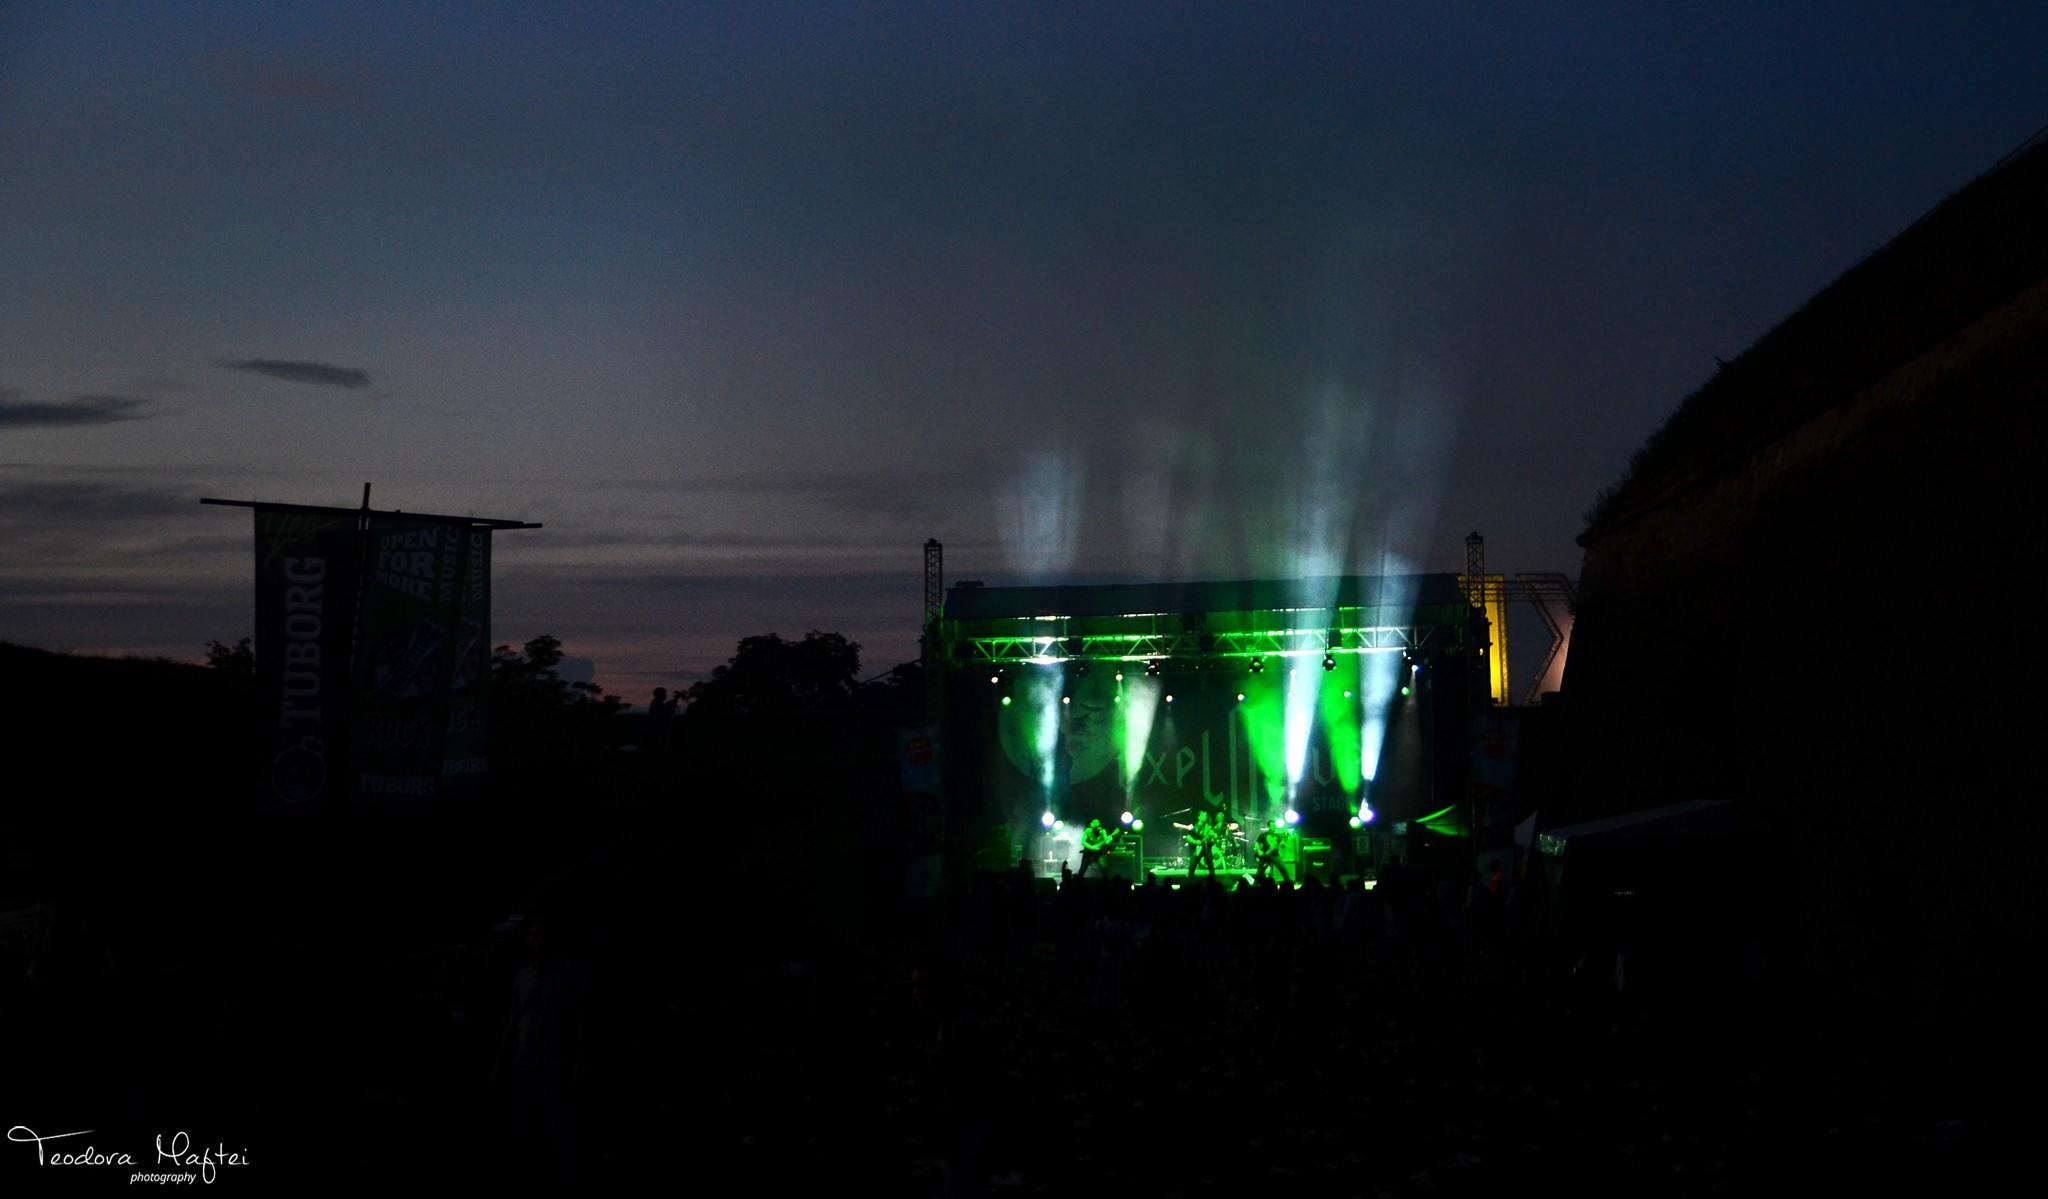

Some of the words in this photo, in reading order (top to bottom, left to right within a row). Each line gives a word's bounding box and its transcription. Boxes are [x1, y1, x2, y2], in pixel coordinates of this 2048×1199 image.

[380, 526, 441, 550] OPEN
[378, 551, 434, 580] FOR
[439, 526, 460, 604] MUSIC
[471, 528, 484, 604] MUSIC
[376, 569, 433, 602] MORE
[278, 557, 327, 728] TUBORG
[357, 772, 436, 797] TUBORG
